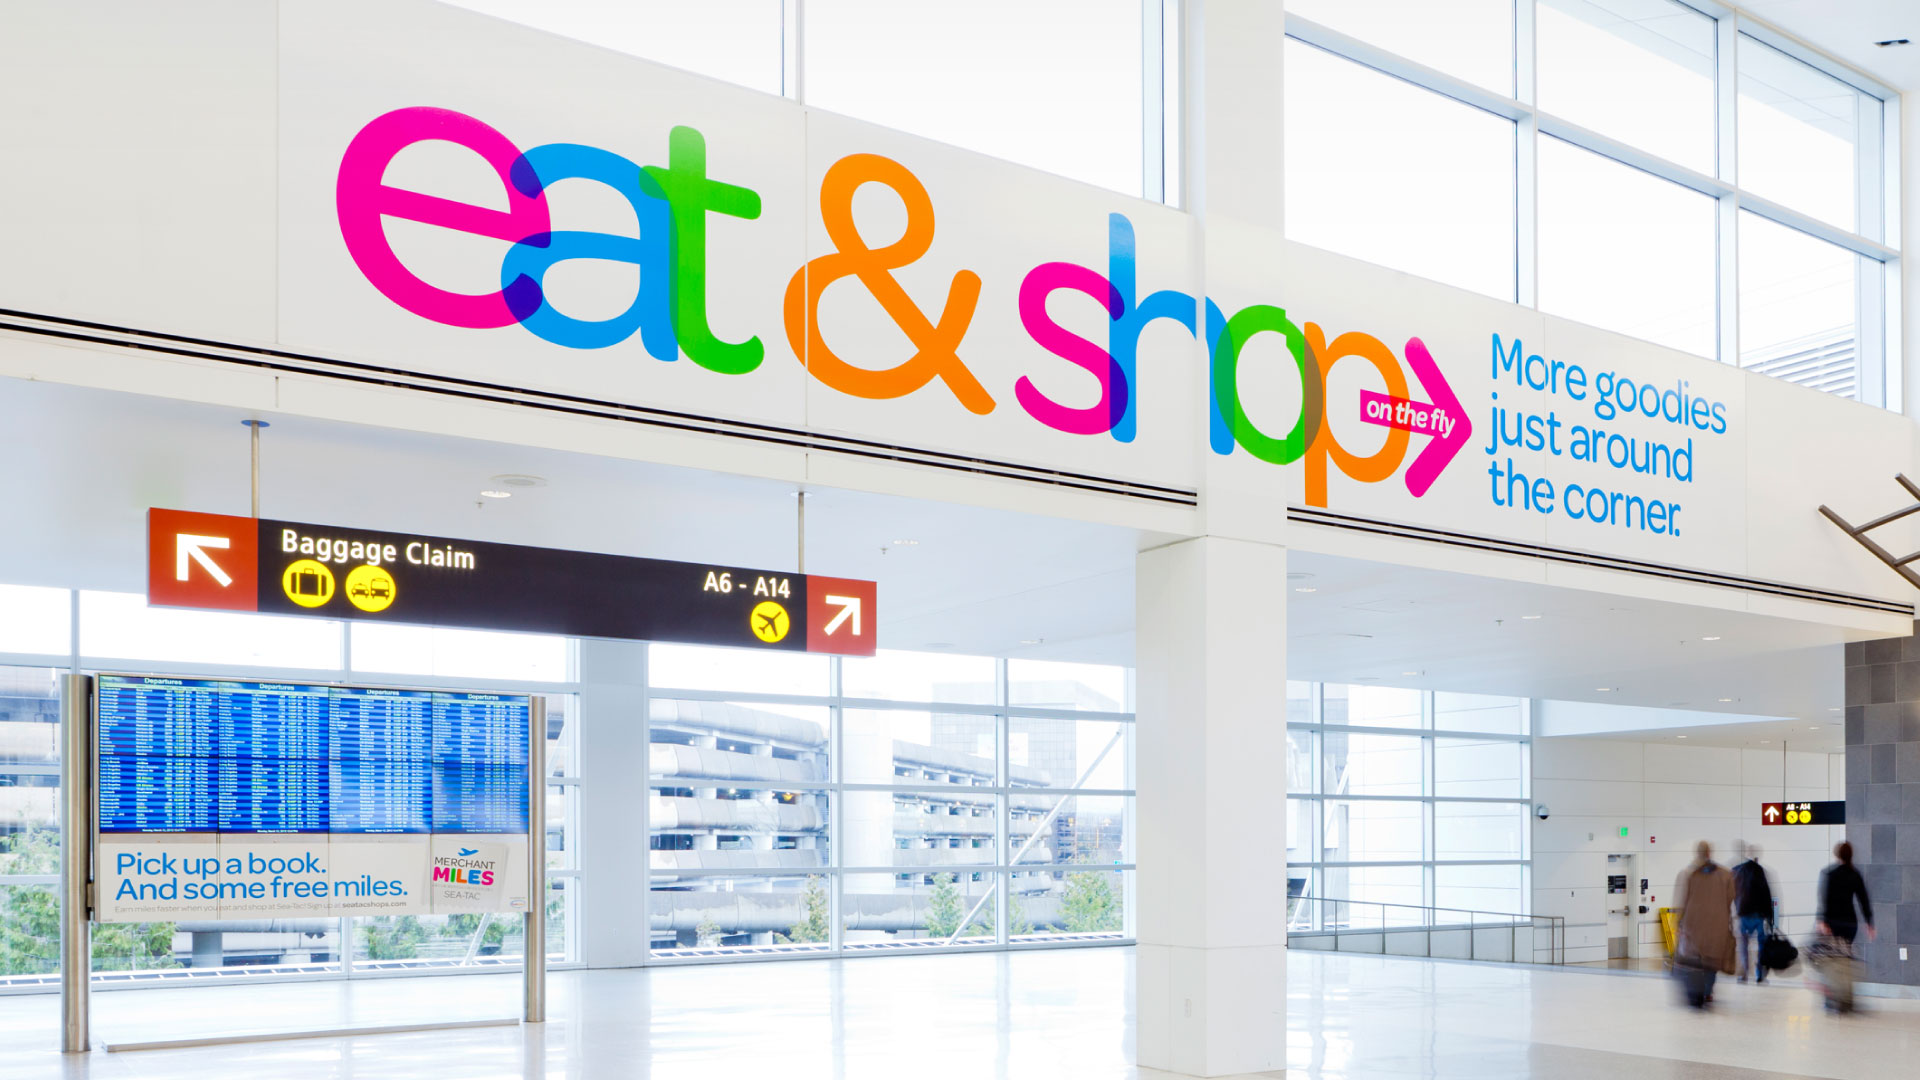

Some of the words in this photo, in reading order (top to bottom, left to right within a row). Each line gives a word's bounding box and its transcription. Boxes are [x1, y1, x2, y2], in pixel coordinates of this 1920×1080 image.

[336, 106, 764, 375] eat
[783, 152, 997, 415] &
[1015, 212, 1410, 508] shop
[1491, 332, 1587, 401] More
[1594, 371, 1727, 434] goodies
[1366, 400, 1392, 421] on
[1395, 402, 1428, 428] the
[1431, 408, 1456, 439] fly
[1485, 392, 1562, 456] just
[1570, 425, 1693, 482] around
[1488, 457, 1555, 514] the
[1563, 483, 1681, 537] corner.
[282, 528, 397, 565] Baggage
[405, 541, 475, 570] Claim
[703, 571, 732, 593] A6
[753, 576, 790, 598] A14
[144, 677, 183, 686] Departures
[259, 683, 295, 691] Departures
[467, 693, 499, 701] Departures
[117, 852, 178, 875] Pick
[183, 858, 220, 880] up
[225, 858, 242, 874] a
[248, 852, 327, 875] book.
[432, 866, 495, 886] MILES
[434, 856, 496, 870] MERCHANT
[115, 877, 177, 900] And
[183, 881, 265, 900] some
[270, 875, 329, 899] free
[334, 874, 409, 897] miles.
[443, 890, 481, 901] SEA-TAC
[342, 900, 407, 909] seatacshops.com
